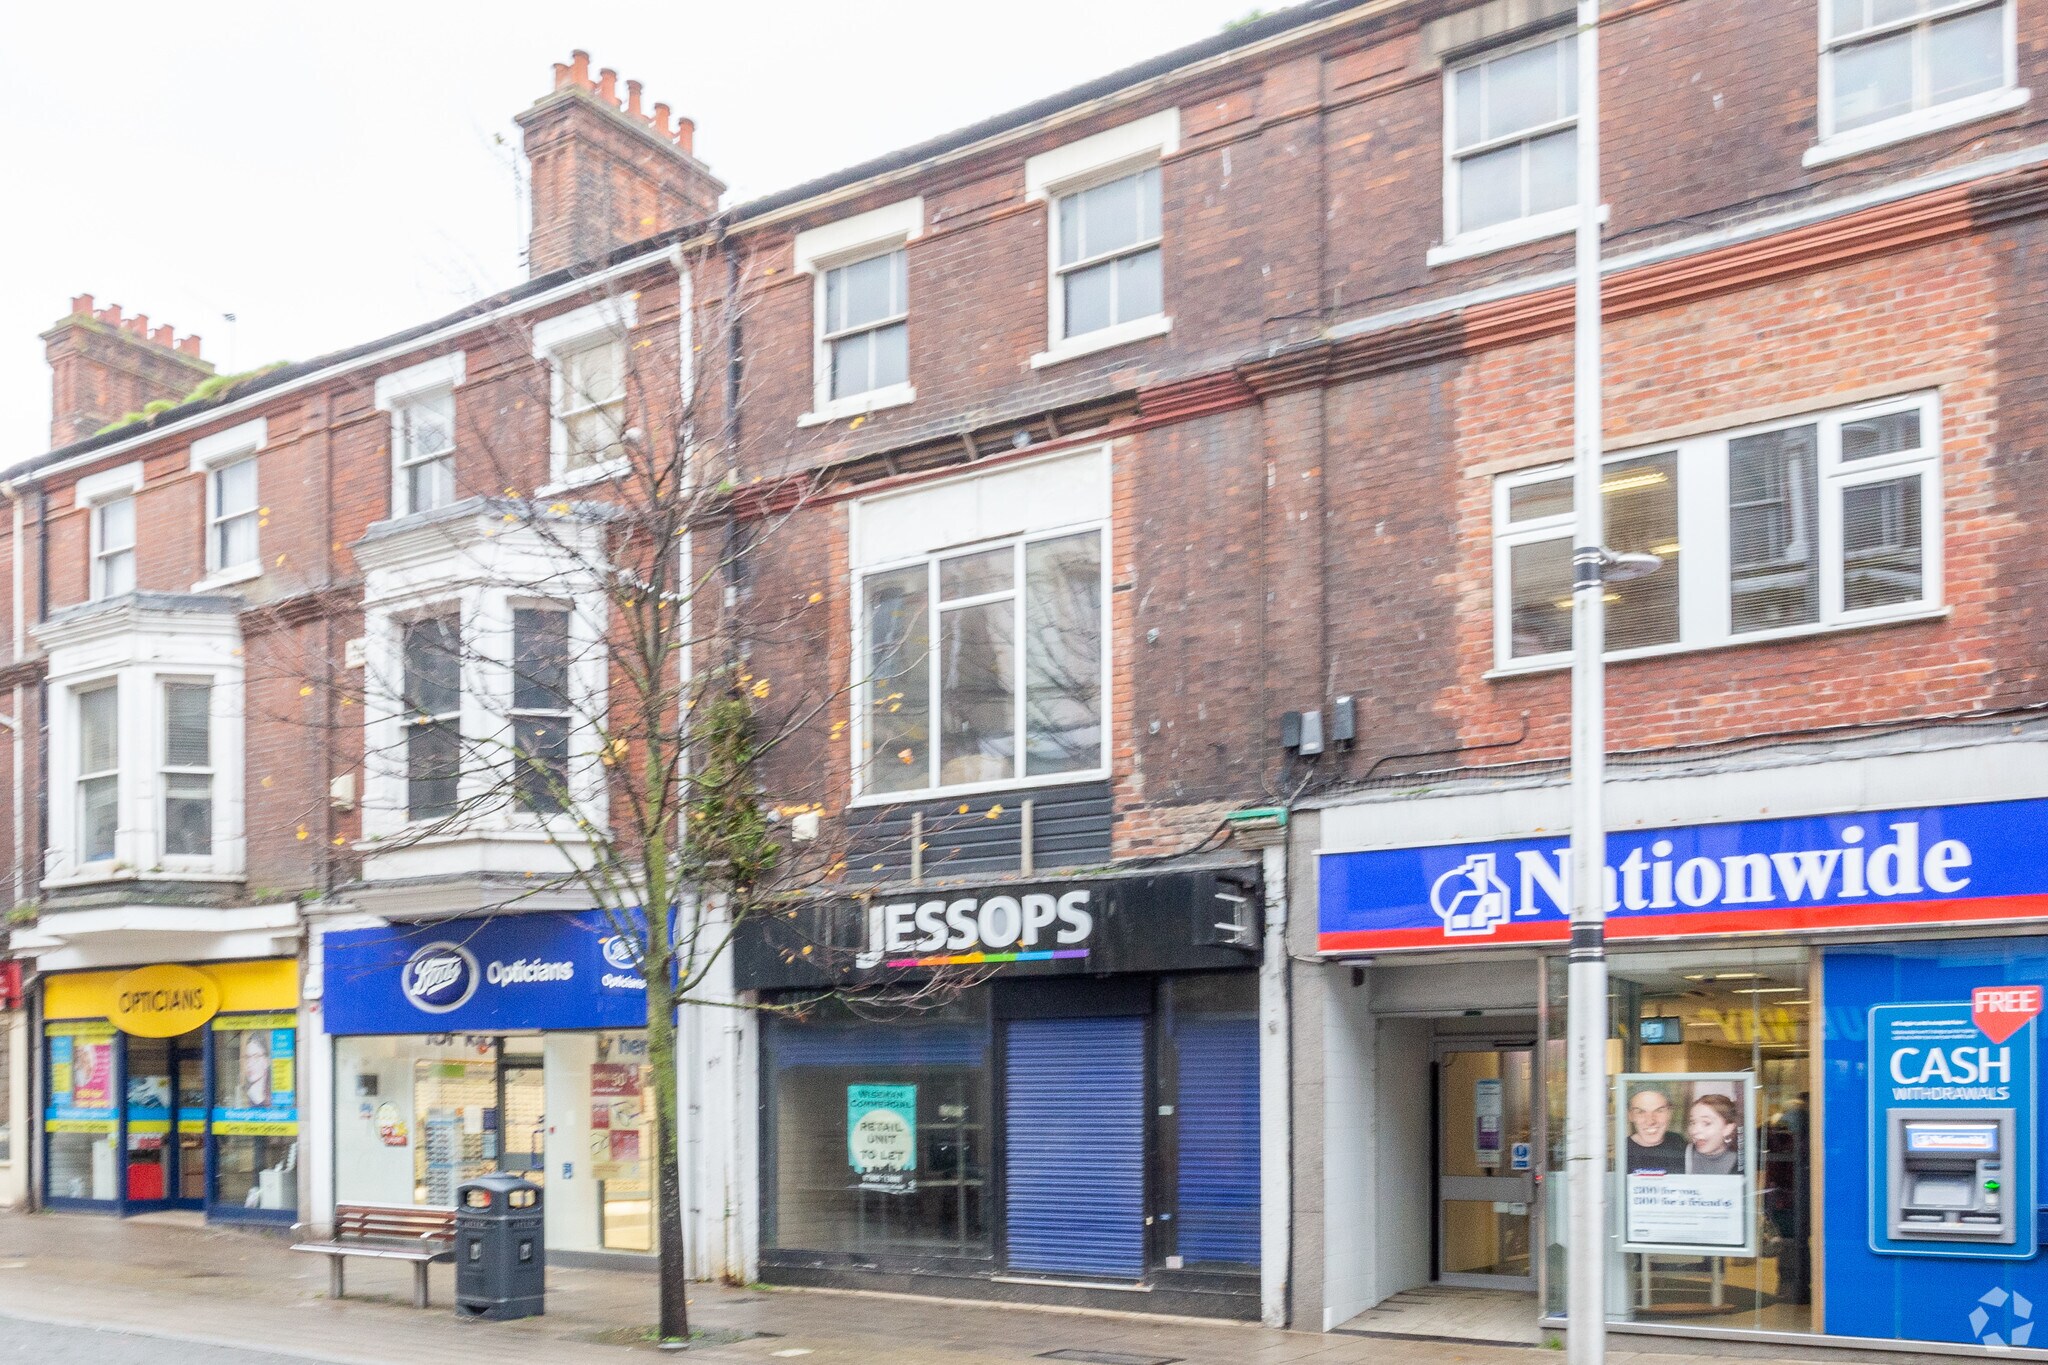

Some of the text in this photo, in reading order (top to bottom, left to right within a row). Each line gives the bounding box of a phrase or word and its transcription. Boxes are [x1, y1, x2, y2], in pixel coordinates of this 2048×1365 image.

[856, 889, 1093, 969] JESSOPS
[486, 958, 574, 987] Opticians
[601, 972, 648, 990] Opticians
[119, 988, 205, 1014] OPTICIANS
[1973, 989, 2039, 1013] FREE
[1889, 1046, 2011, 1085] CASH
[1891, 1086, 2011, 1101] WITHDRAWALS
[850, 1100, 914, 1109] COMMERCIAL
[860, 1121, 904, 1132] RETAIL
[867, 1135, 897, 1145] UNIT
[860, 1150, 905, 1161] TO LET
